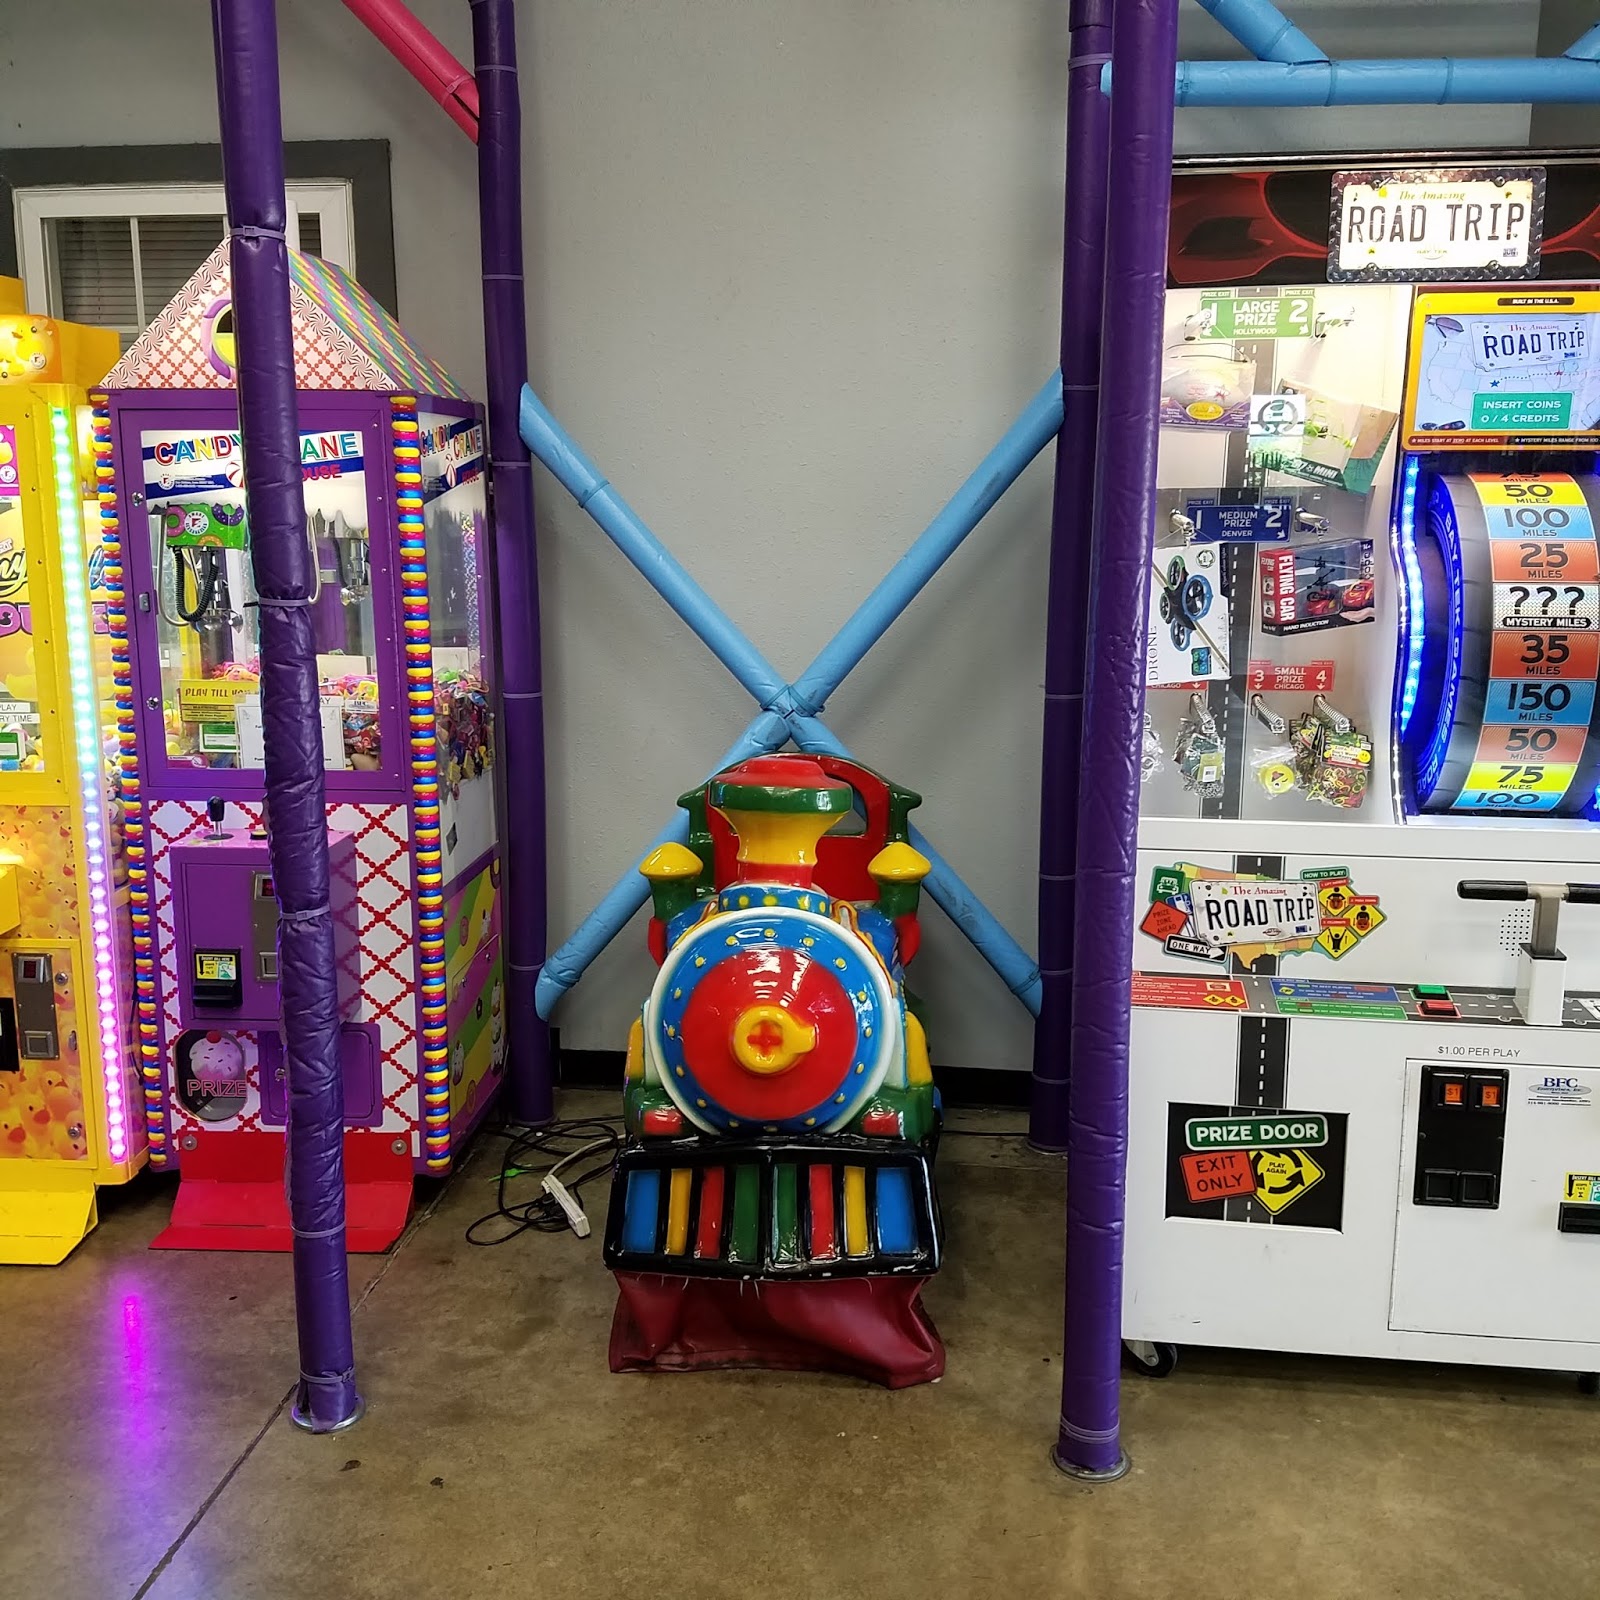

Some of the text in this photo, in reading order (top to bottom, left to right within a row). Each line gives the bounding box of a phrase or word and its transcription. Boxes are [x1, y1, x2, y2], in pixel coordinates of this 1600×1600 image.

[1399, 190, 1466, 201] The Amazing
[1347, 203, 1525, 243] ROAD TRIP
[1232, 300, 1280, 313] LARGE
[1288, 299, 1308, 323] 2
[1234, 312, 1277, 326] PRIZE
[1233, 327, 1278, 336] HOLLYWOOD
[1509, 324, 1527, 332] The
[1483, 330, 1585, 359] ROAD TRIP
[1483, 400, 1562, 409] INSERT COINS
[1499, 415, 1509, 423] 4
[1512, 414, 1560, 423] CREDITS
[420, 423, 451, 457] CANDY
[453, 428, 482, 460] CRANE
[301, 432, 359, 462] ANE
[1312, 465, 1339, 479] MINI
[1503, 484, 1553, 498] 50
[1195, 509, 1203, 530] 1
[1219, 511, 1258, 520] MEDIUM
[1265, 508, 1282, 528] 2
[1504, 508, 1570, 528] 100
[1223, 519, 1252, 528] PRIZE
[1523, 529, 1557, 537] MILES
[1519, 543, 1569, 568] 25
[1528, 570, 1563, 579] MILES
[1278, 555, 1296, 622] FLYING CAR
[1283, 624, 1299, 632] HAND
[1300, 619, 1330, 629] INDUCTION
[1441, 511, 1461, 744] BAY TEK GAMES
[1506, 617, 1588, 627] MYSTERY MILES
[1147, 625, 1159, 681] DRONE
[1520, 634, 1570, 664] 35
[1254, 669, 1265, 682] 3
[1274, 667, 1307, 675] SMALL
[1315, 670, 1327, 682] 4
[1526, 666, 1561, 675] MILES
[1276, 675, 1304, 683] PRIZE
[185, 687, 208, 697] PLAY
[211, 688, 229, 697] TILL
[1507, 683, 1571, 712] 150
[1518, 712, 1553, 721] MILES
[1504, 728, 1557, 752] 50
[1510, 753, 1545, 761] MILES
[1497, 765, 1544, 784] 75
[1475, 792, 1540, 805] 100
[1232, 885, 1288, 896] The Amazing
[1153, 908, 1170, 918] PRIZE
[1205, 898, 1269, 931] ROAD
[1275, 897, 1314, 924] TRIP
[1156, 916, 1172, 925] ZONE
[1157, 924, 1177, 933] AHEAD
[1172, 941, 1211, 954] ONE WAY
[1437, 1046, 1521, 1058] $1.00 PER PLAY
[187, 1079, 247, 1097] PRIZE
[1543, 1077, 1578, 1088] BFC
[1446, 1087, 1460, 1097] $1
[1485, 1090, 1497, 1100] $1
[1196, 1123, 1319, 1142] PRIZE DOOR
[1196, 1156, 1236, 1174] EXIT
[1266, 1167, 1287, 1175] AGAIN
[1268, 1161, 1286, 1169] PLAY
[1196, 1173, 1244, 1193] ONLY
